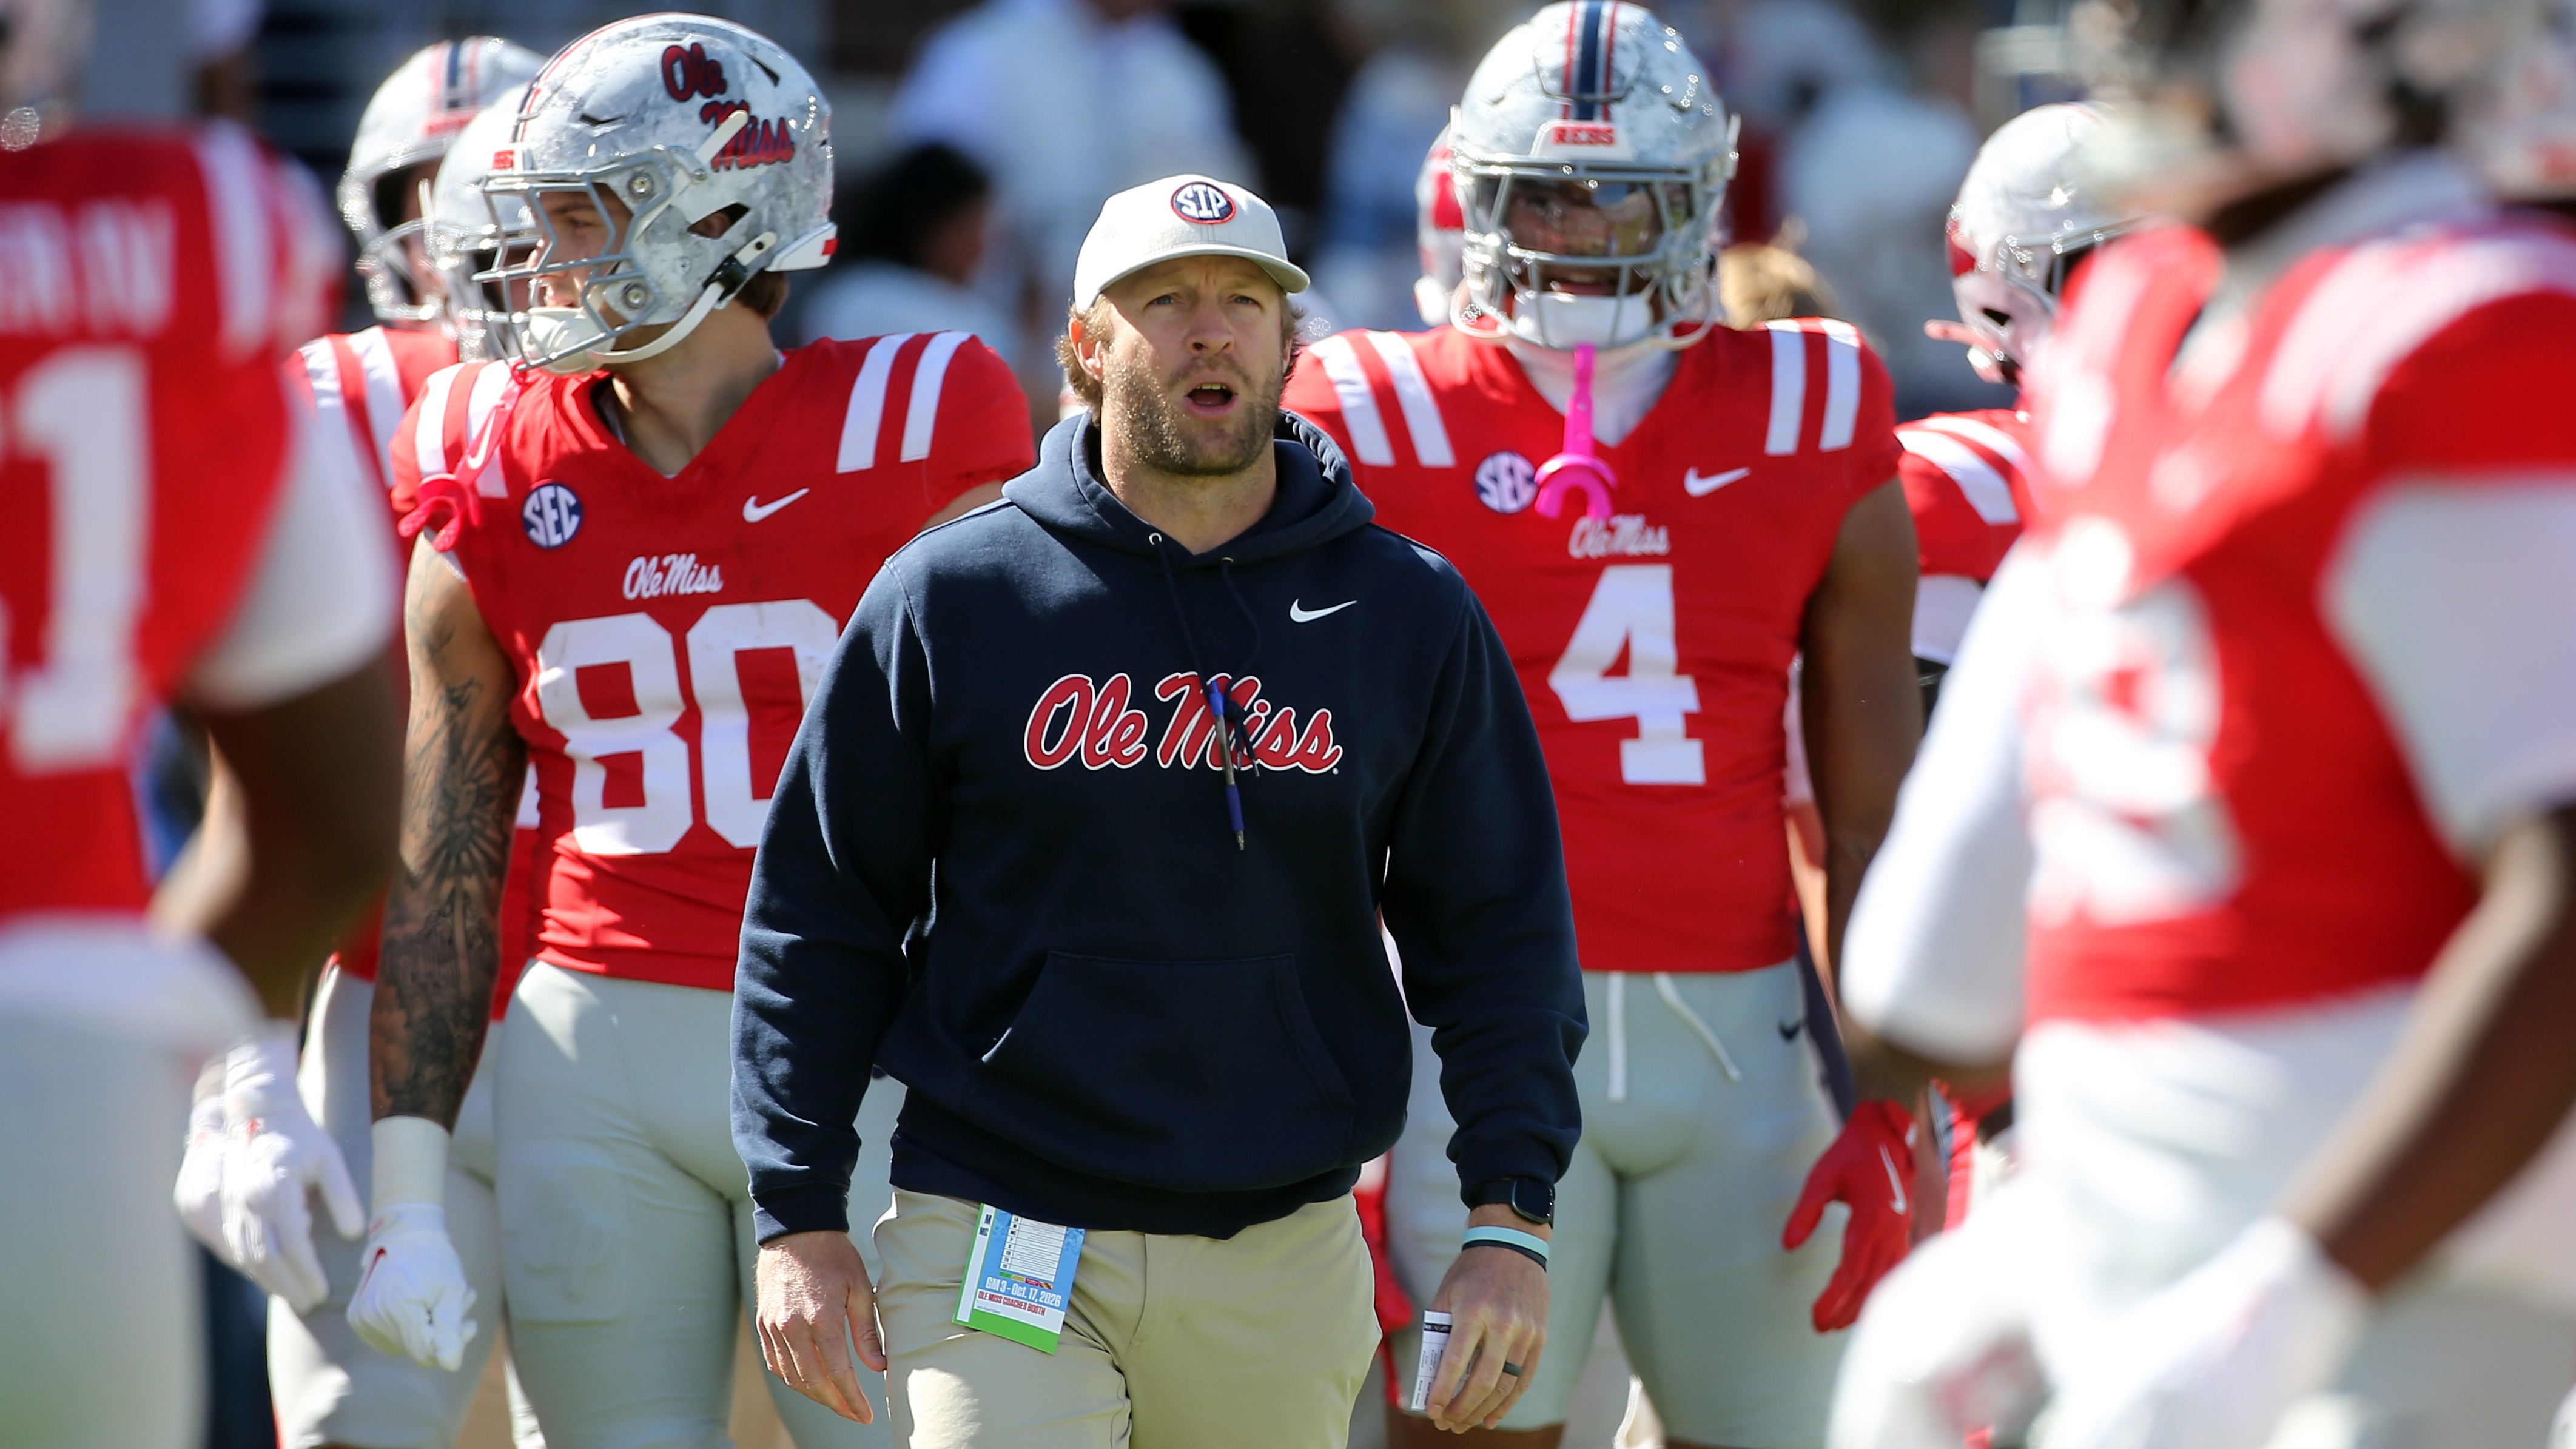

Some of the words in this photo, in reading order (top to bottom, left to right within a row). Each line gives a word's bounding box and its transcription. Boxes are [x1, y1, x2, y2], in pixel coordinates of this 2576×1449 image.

[662, 43, 727, 102] Ole
[700, 100, 795, 172] Miss
[1552, 126, 1615, 146] REBS
[1175, 184, 1228, 218] SIP
[1475, 452, 1537, 513] SEC
[523, 485, 580, 547] SEC
[1609, 514, 1671, 556] Miss
[622, 556, 663, 600] Ole
[662, 553, 724, 596] Miss
[1547, 564, 1706, 785] 4
[537, 598, 838, 855] 80
[1024, 673, 1148, 770] Ole
[1155, 671, 1343, 774] Miss
[978, 1226, 989, 1236] MC
[978, 1291, 988, 1300] OLE
[987, 1293, 1003, 1304] MISS
[1003, 1297, 1027, 1310] COACHES
[1027, 1303, 1046, 1316] BOOTH
[985, 1276, 1001, 1292] GM
[1000, 1280, 1007, 1293] 3
[1011, 1283, 1027, 1299] Oct.
[1029, 1288, 1038, 1303] 17,
[1039, 1291, 1062, 1308] 2026
